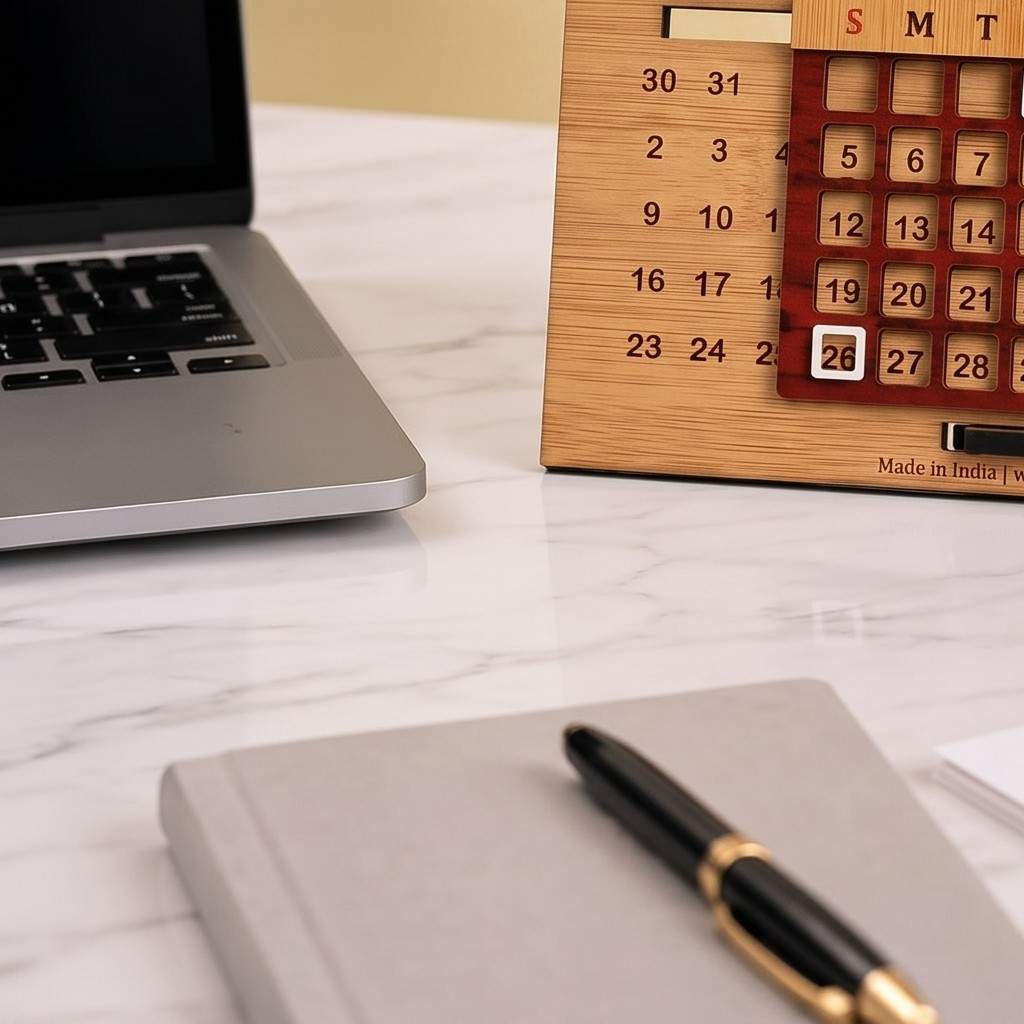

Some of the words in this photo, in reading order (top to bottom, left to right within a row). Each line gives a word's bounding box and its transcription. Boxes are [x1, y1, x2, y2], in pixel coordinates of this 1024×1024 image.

[846, 8, 863, 35] S
[905, 11, 934, 37] M
[977, 15, 997, 40] T
[642, 69, 676, 92] 30
[708, 72, 738, 95] 31
[647, 136, 663, 159] 2
[712, 139, 727, 162] 3
[842, 145, 857, 168] 5
[908, 149, 923, 172] 6
[974, 152, 989, 176] 7
[644, 202, 659, 225] 9
[700, 205, 732, 229] 10
[830, 212, 866, 238] 12
[895, 216, 929, 241] 13
[961, 220, 996, 244] 14
[632, 267, 664, 292] 16
[695, 271, 730, 296] 17
[760, 275, 780, 301] 1
[826, 279, 862, 305] 19
[891, 282, 926, 307] 20
[959, 286, 994, 314] 21
[627, 334, 661, 358] 23
[690, 338, 725, 362] 24
[756, 341, 777, 365] 2
[822, 345, 855, 371] 26
[887, 350, 924, 374] 27
[954, 354, 989, 379] 28
[879, 458, 924, 474] Made
[930, 461, 946, 476] in
[953, 462, 996, 479] India
